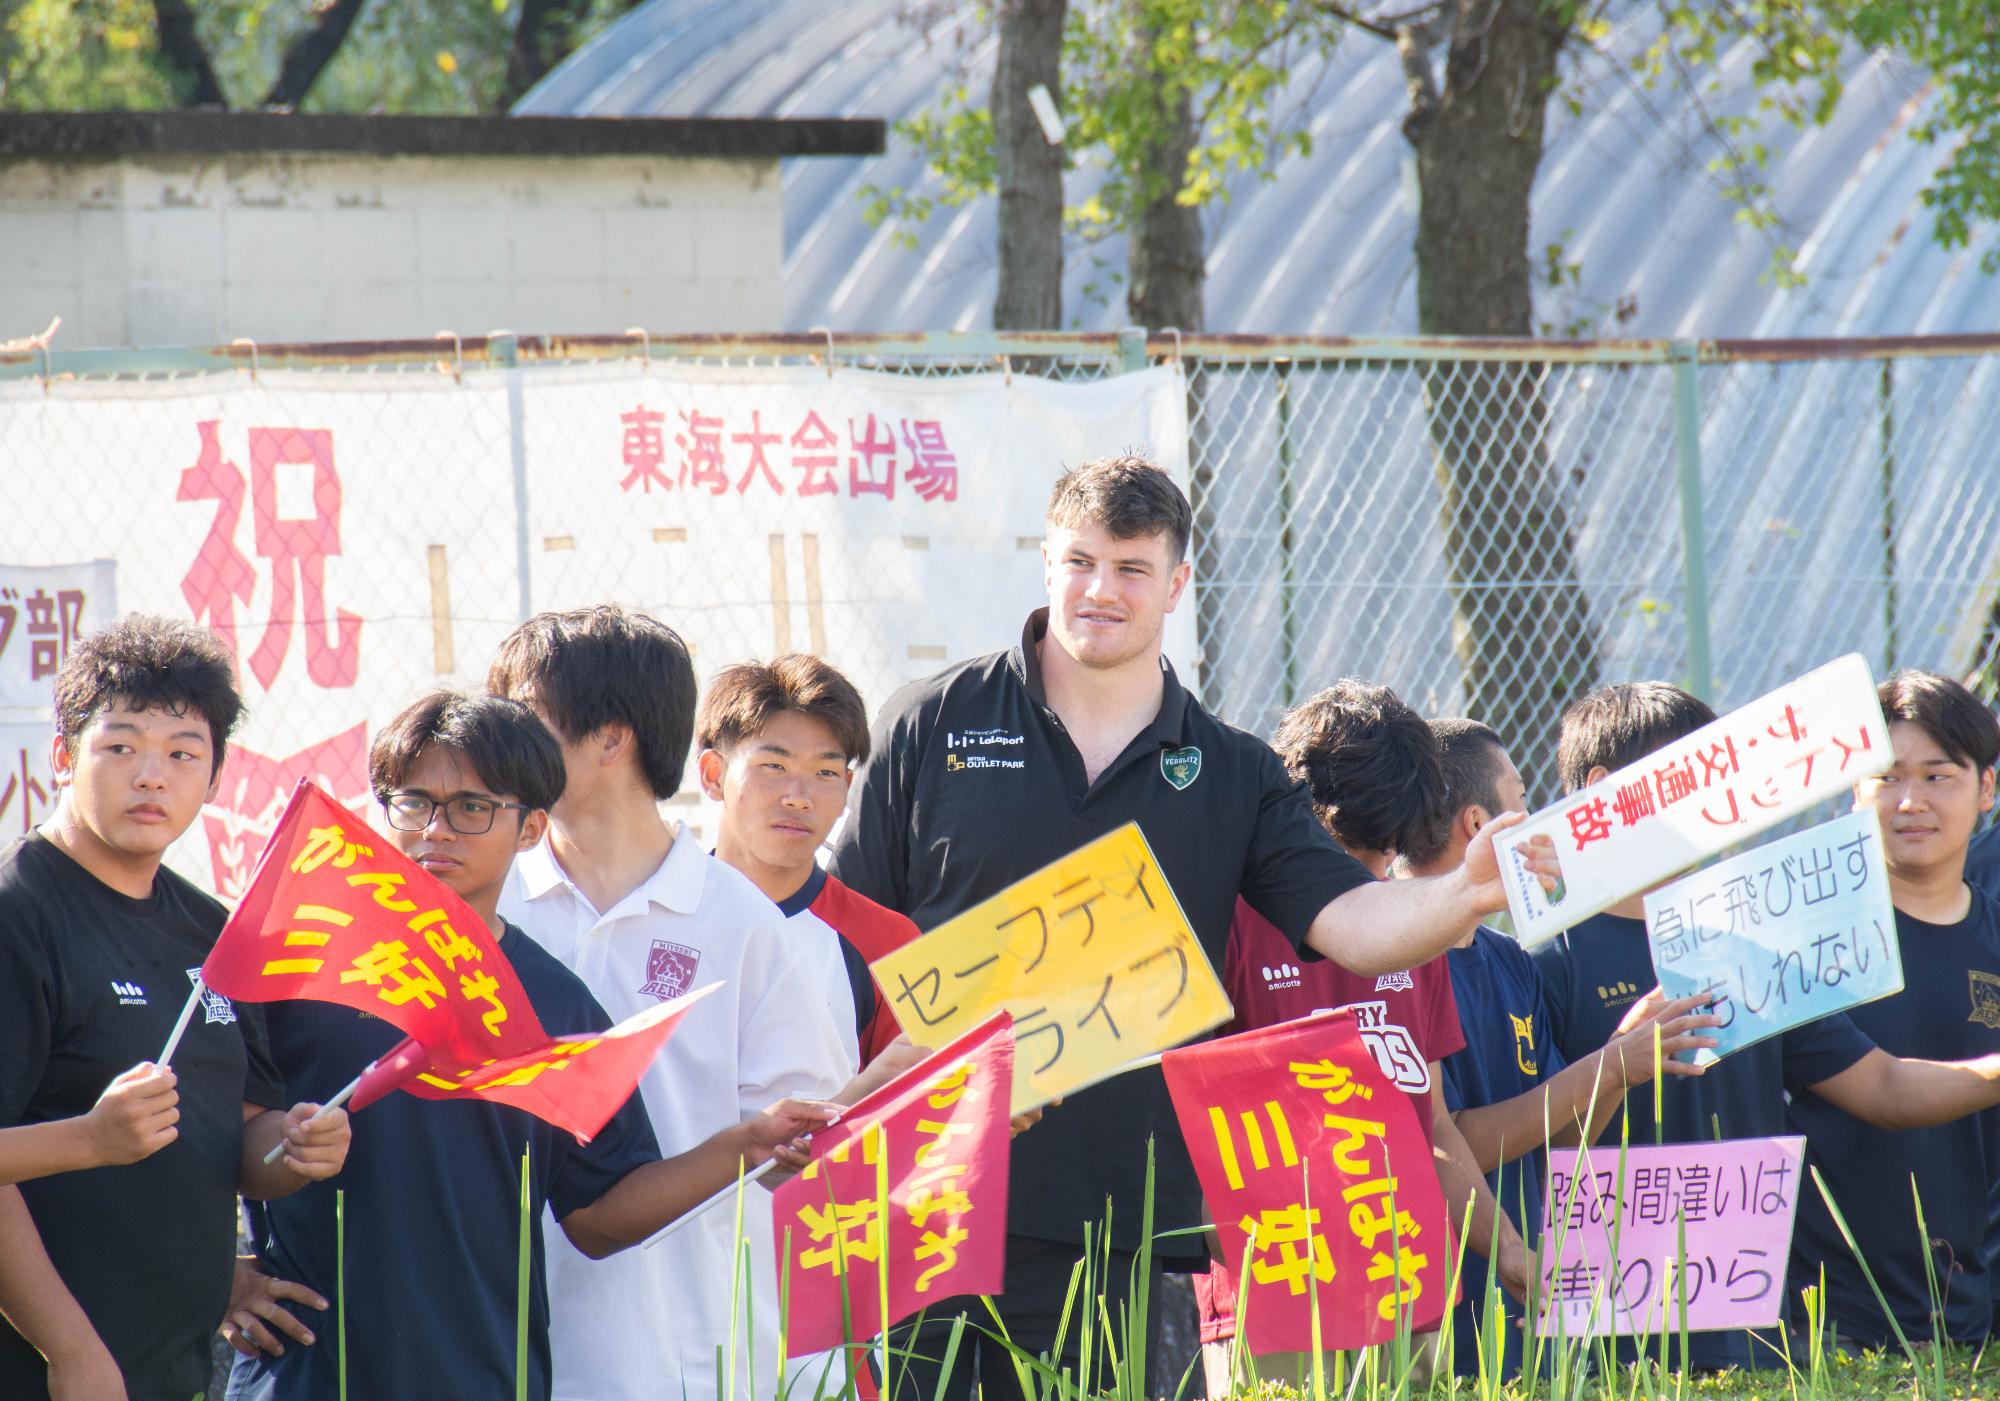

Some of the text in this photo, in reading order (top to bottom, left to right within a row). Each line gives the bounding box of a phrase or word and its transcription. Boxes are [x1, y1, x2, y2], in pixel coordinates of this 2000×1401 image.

[620, 404, 957, 502] 東海大会出場
[176, 419, 363, 692] 祝
[966, 761, 1025, 769] OUTLET PARK
[979, 735, 1025, 746] LaLaport
[1566, 704, 1808, 851] ザ・交通事故
[1701, 725, 1872, 825] ストップ
[290, 824, 509, 1037] がんばれ
[1654, 831, 1872, 968] 急に飛び出す
[261, 904, 448, 1010] 三好
[643, 980, 684, 999] REDS
[1012, 930, 1190, 1076] ライブ
[1268, 979, 1301, 991] amicotte
[1675, 919, 1891, 1031] もしれない
[1208, 1100, 1337, 1296] 三好
[1289, 1058, 1428, 1321] がんばれ
[1547, 1158, 1793, 1230] 踏み間違いは
